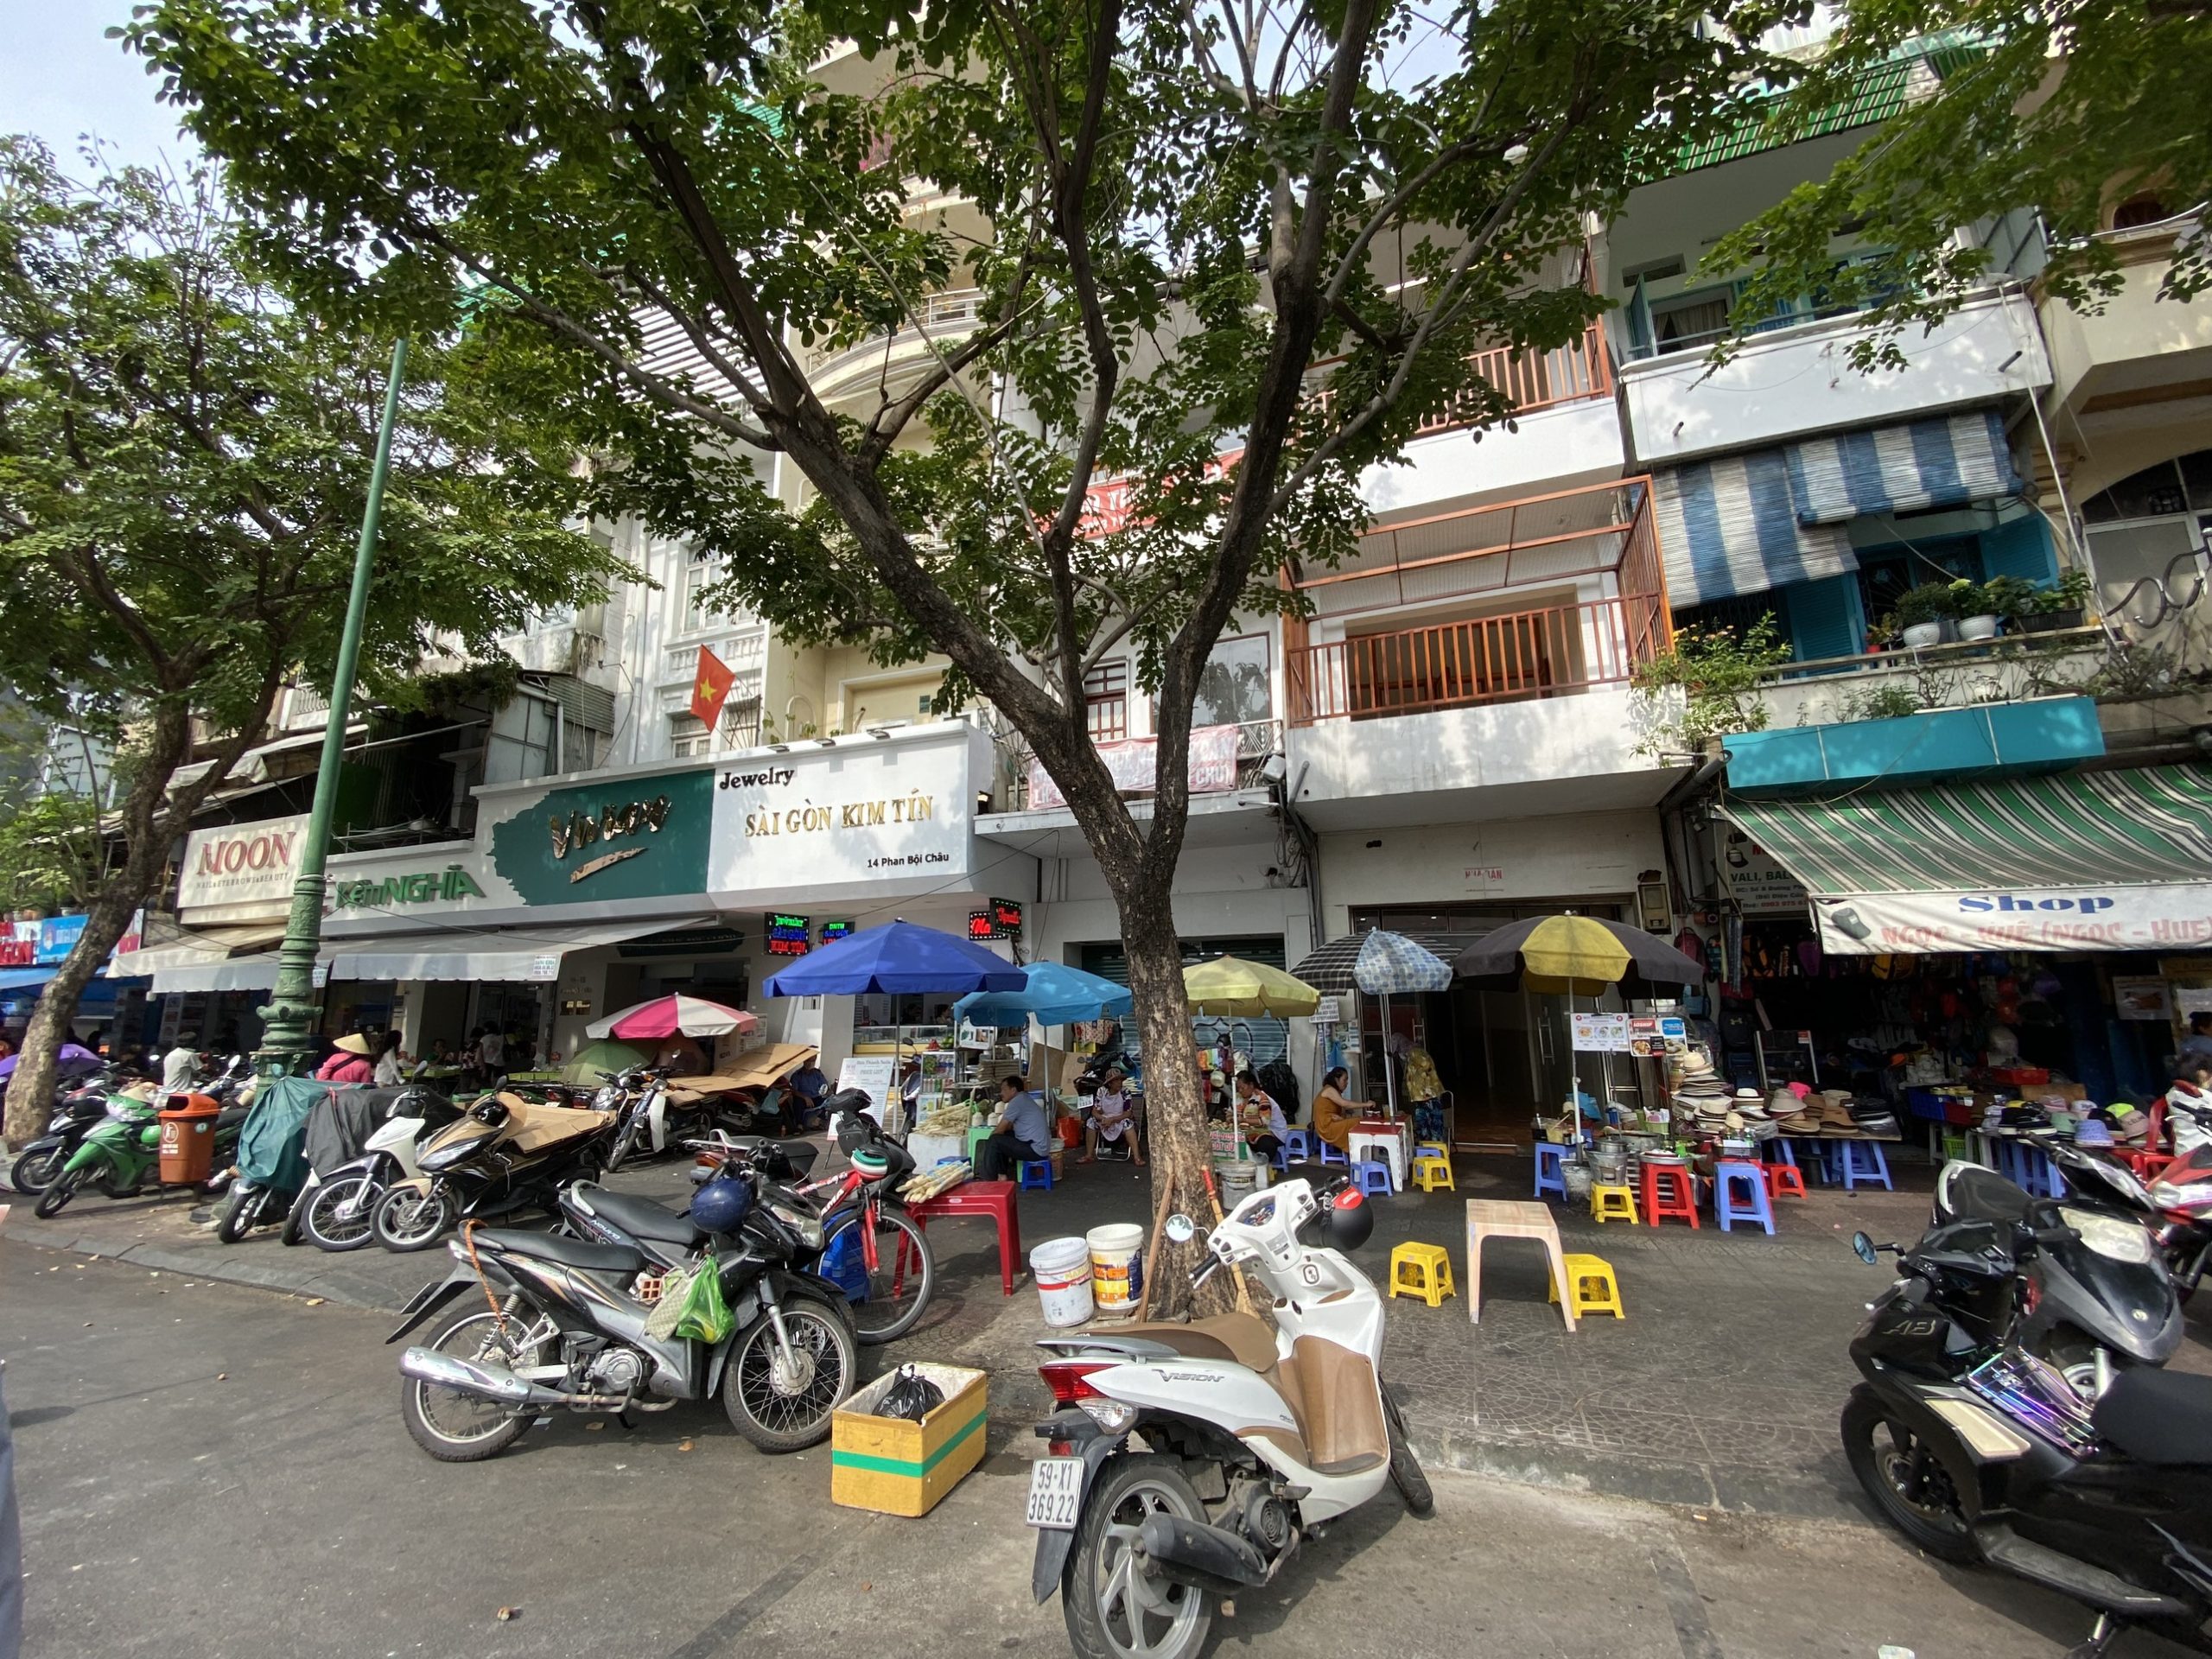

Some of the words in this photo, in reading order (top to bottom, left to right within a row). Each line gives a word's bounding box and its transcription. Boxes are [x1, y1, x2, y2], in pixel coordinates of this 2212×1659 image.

[719, 767, 794, 790] Jewelry
[745, 804, 780, 836] SÀI
[785, 798, 831, 833] GÒN
[841, 801, 886, 829] KIM
[892, 788, 933, 823] TÍN
[196, 831, 297, 876] MOON
[867, 858, 879, 868] 14
[881, 856, 905, 867] Phan
[907, 855, 923, 866] Bội
[925, 852, 950, 863] Châu
[1731, 872, 1762, 881] VALI,
[1957, 894, 2114, 914] Shop
[1152, 1369, 1225, 1382] VISION
[1028, 1494, 1076, 1522] 369.22
